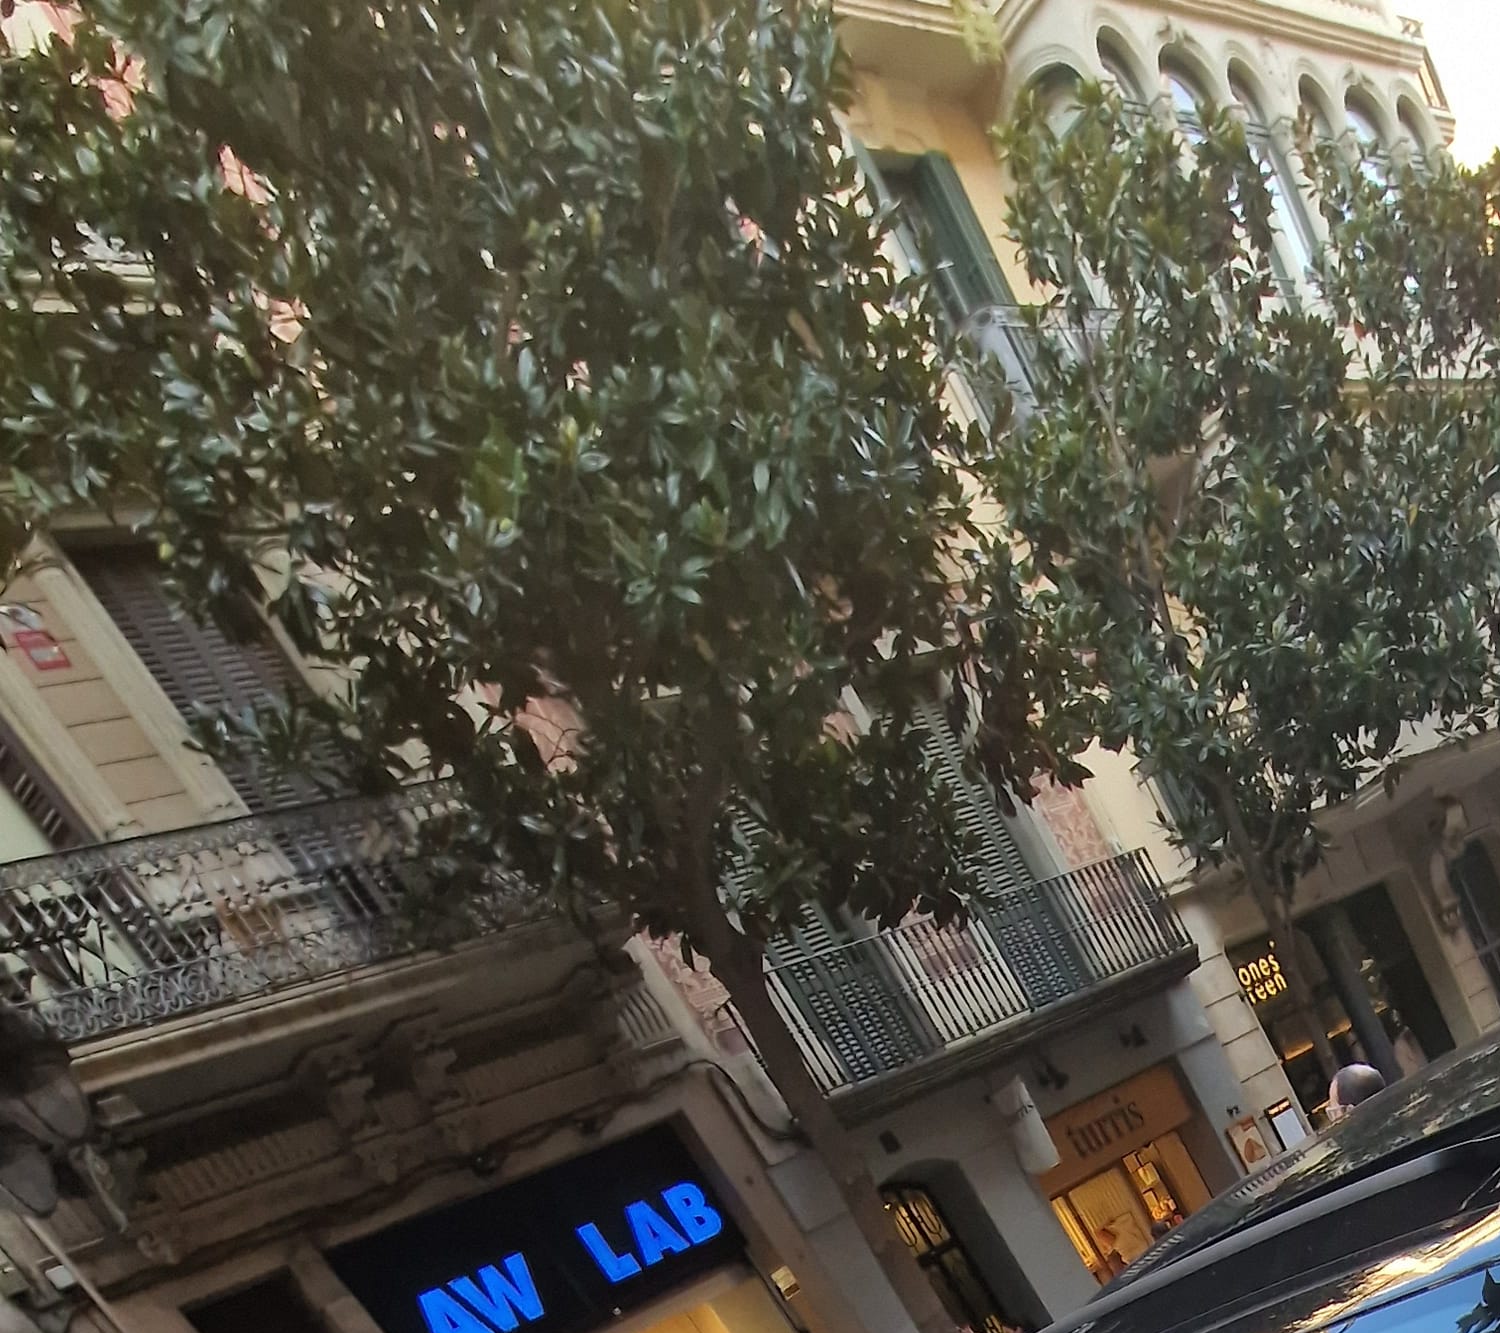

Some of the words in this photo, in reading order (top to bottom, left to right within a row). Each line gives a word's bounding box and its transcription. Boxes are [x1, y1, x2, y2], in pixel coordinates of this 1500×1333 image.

[1238, 953, 1281, 986] ones
[1064, 1096, 1145, 1160] turris
[574, 1178, 724, 1286] LAB
